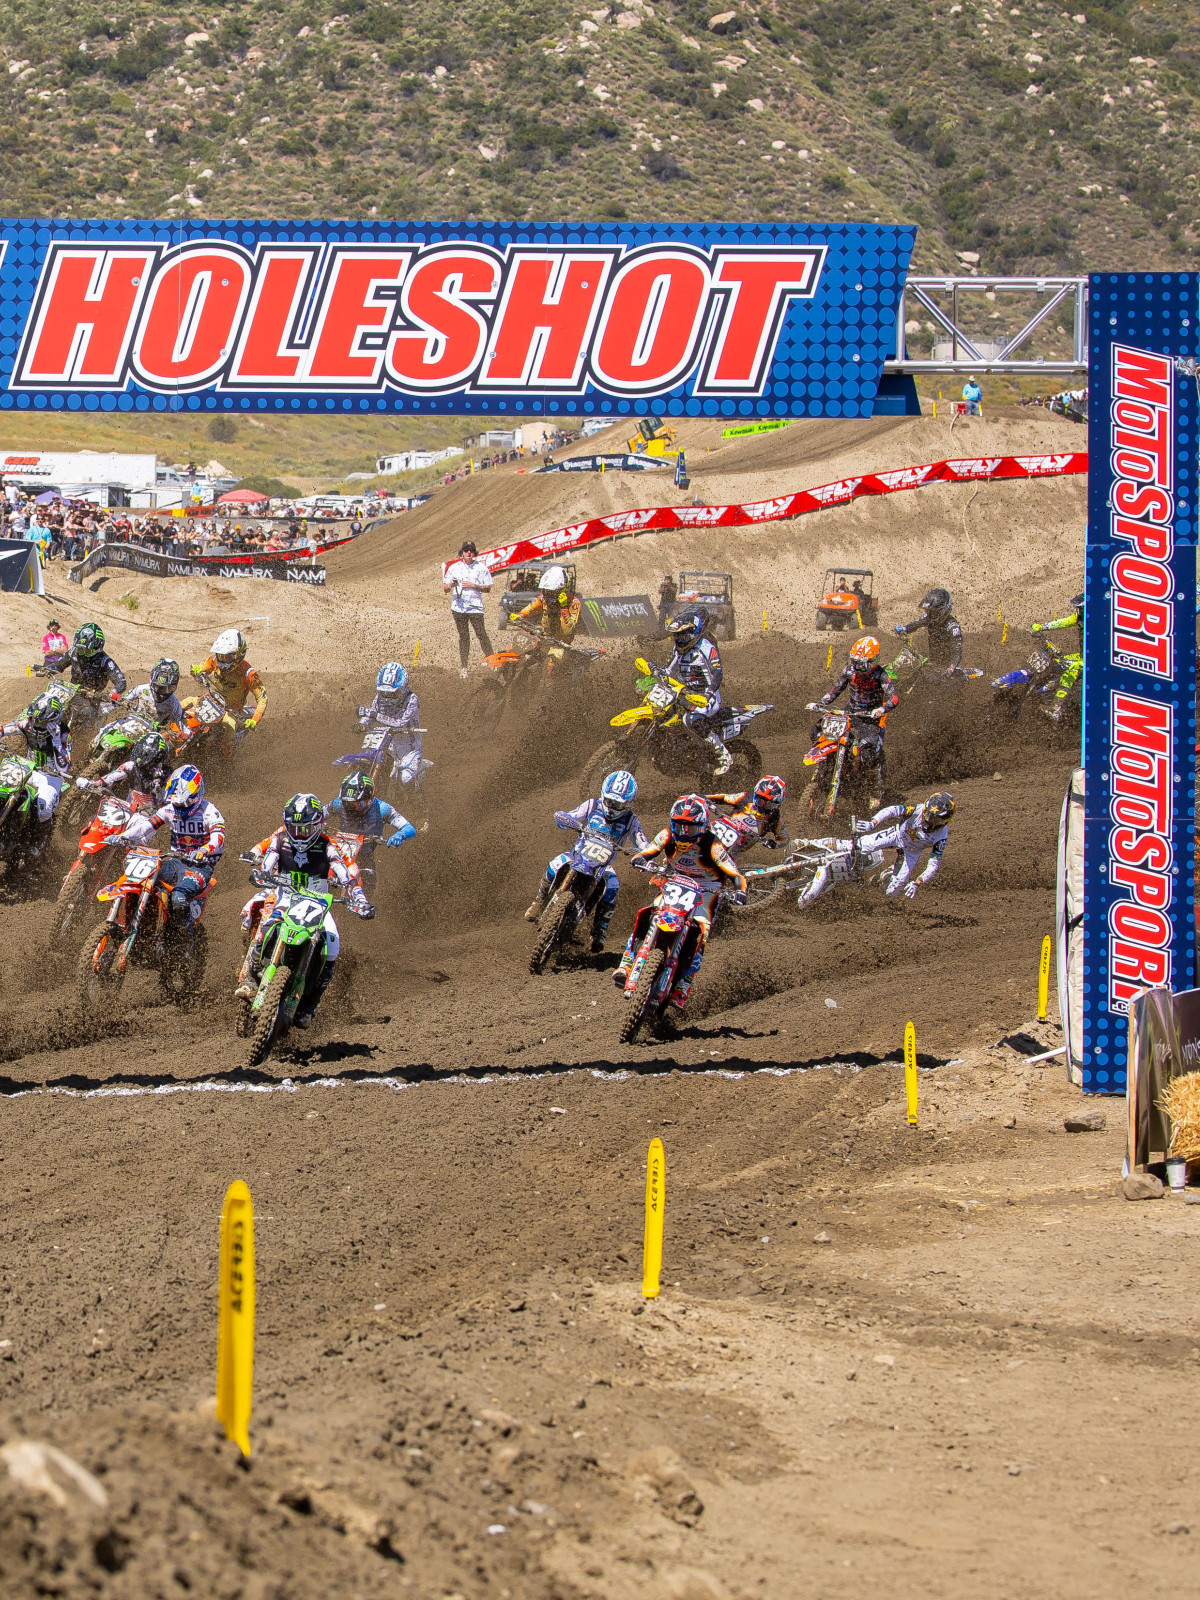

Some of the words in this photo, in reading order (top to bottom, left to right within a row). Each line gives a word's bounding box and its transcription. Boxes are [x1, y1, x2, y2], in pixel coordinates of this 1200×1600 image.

[8, 239, 829, 397] HOLESHOT
[5, 456, 40, 465] GEAR
[949, 459, 1003, 473] FLY
[1018, 455, 1074, 470] FLY
[878, 466, 933, 488] FLY
[811, 478, 863, 502] FLY
[675, 507, 729, 520] FLY
[743, 495, 796, 518] FLY
[1110, 342, 1174, 682] MOTOSPORT
[603, 510, 657, 527] FLY
[532, 524, 589, 549] FLY
[166, 563, 209, 577] NAMURA
[1113, 654, 1155, 673] .com
[124, 859, 155, 879] 16
[664, 884, 698, 912] 34
[288, 900, 326, 926] 47
[651, 1158, 659, 1213] ACERBIS
